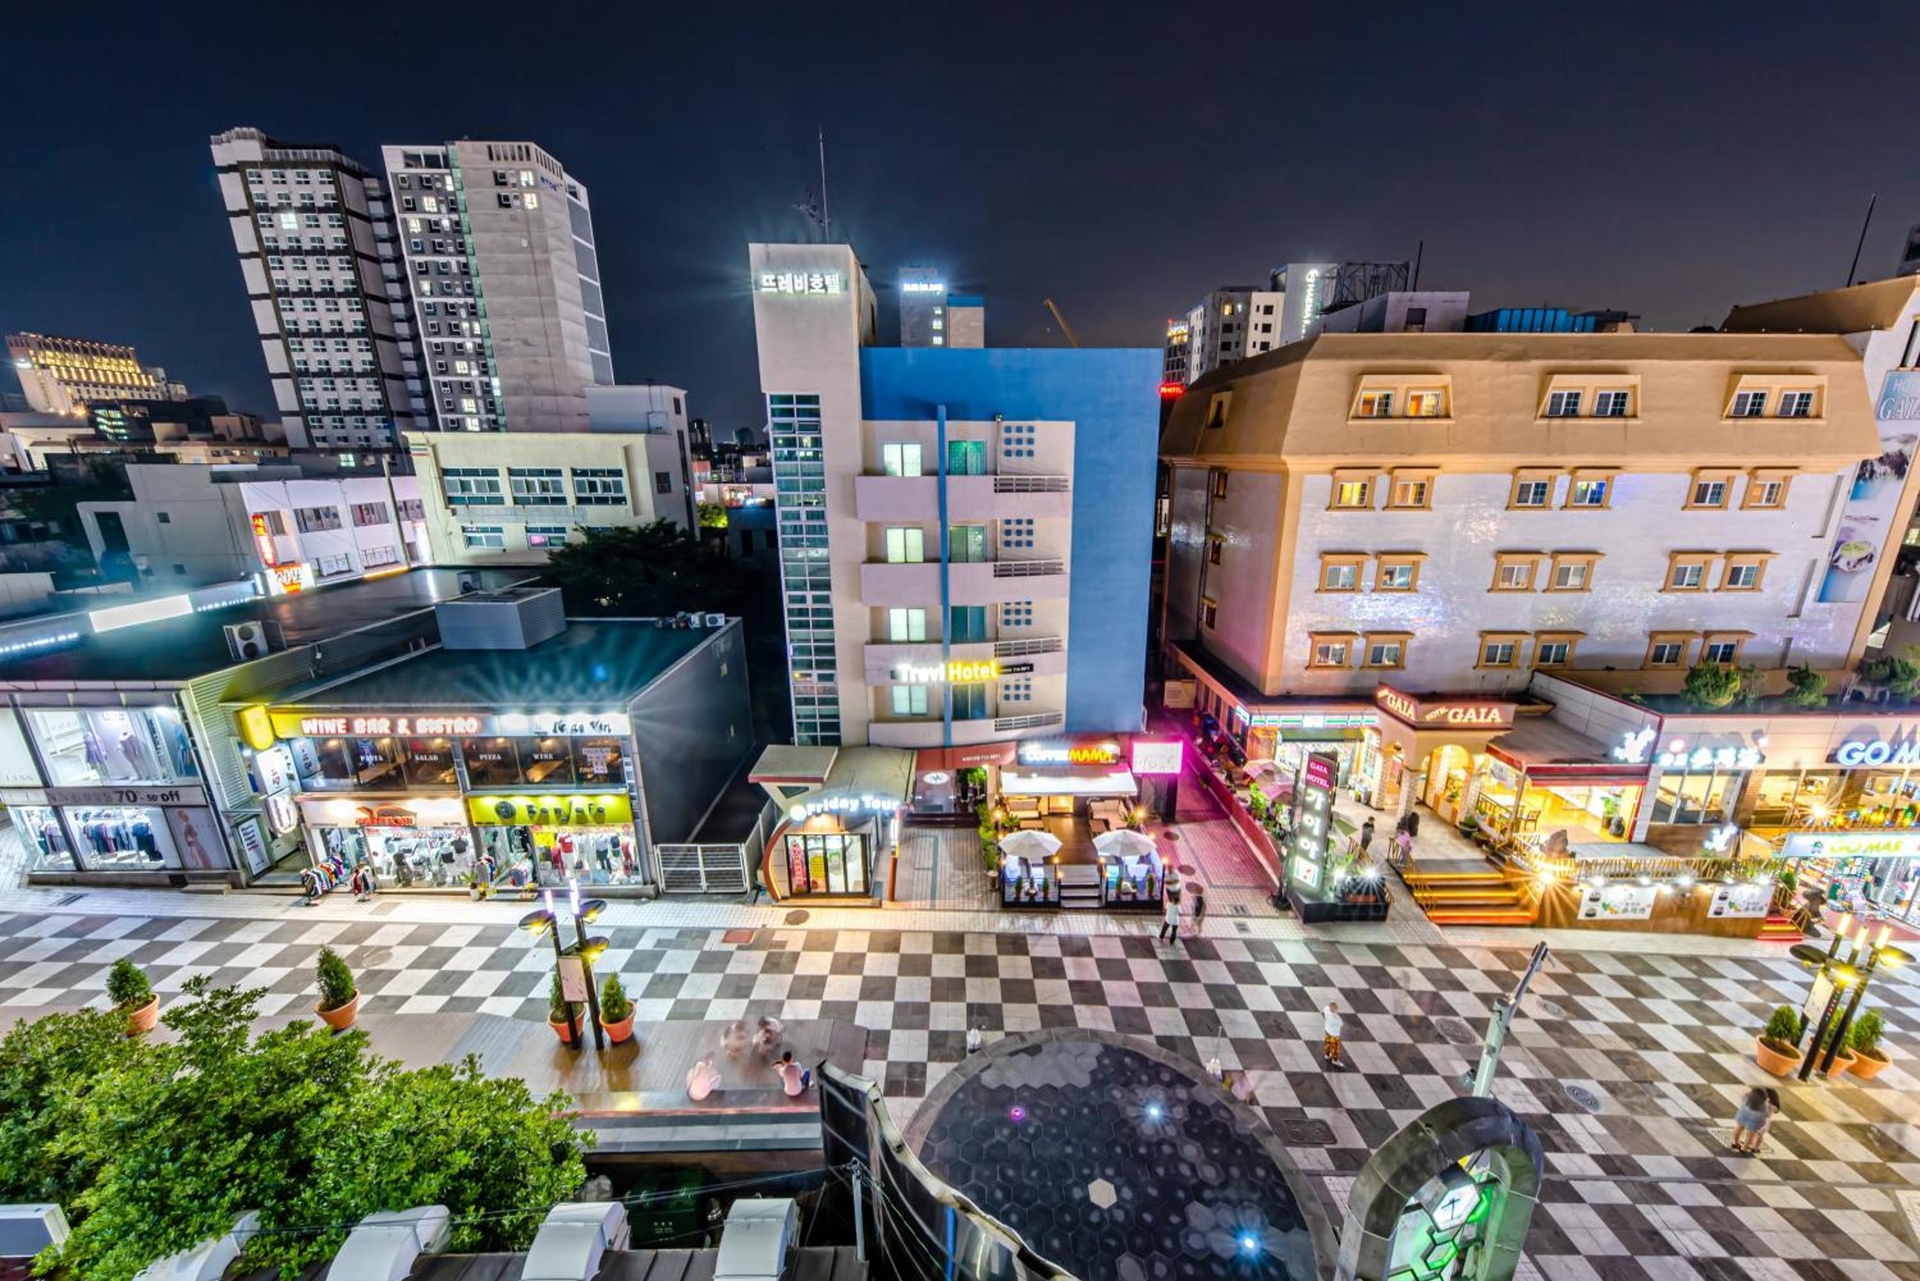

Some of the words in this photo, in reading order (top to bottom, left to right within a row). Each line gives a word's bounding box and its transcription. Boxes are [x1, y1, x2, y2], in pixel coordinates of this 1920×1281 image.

[948, 660, 999, 681] Hotel
[1387, 694, 1416, 720] GAIA
[1448, 708, 1503, 723] GAIA
[301, 718, 349, 734] WINE
[354, 718, 392, 734] BAR
[397, 718, 411, 734] &
[416, 717, 480, 734] BISTRO
[1069, 748, 1112, 762] MAMA
[1309, 760, 1329, 774] GAIA
[1307, 774, 1329, 788] HOTEL
[161, 790, 181, 802] off
[806, 797, 859, 816] Friday
[861, 796, 900, 811] Tour
